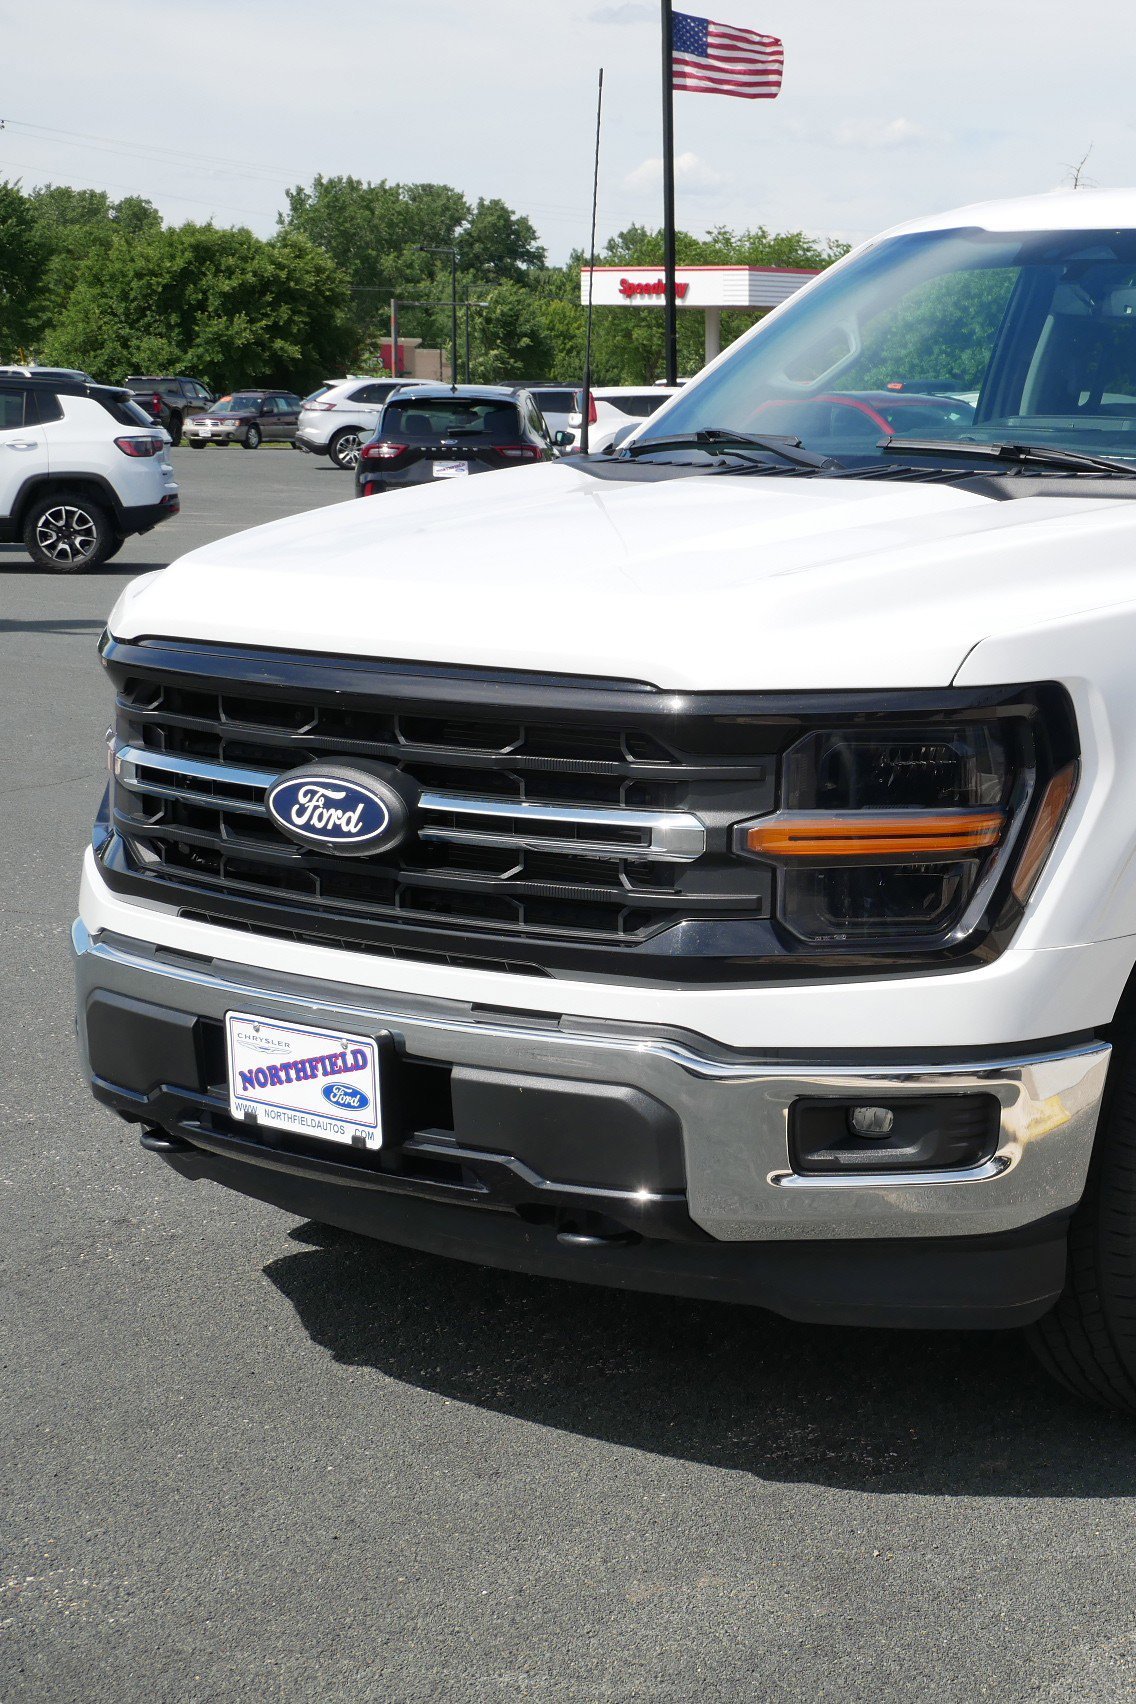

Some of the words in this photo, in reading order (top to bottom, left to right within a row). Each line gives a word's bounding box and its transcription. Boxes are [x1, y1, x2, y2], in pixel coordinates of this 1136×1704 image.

[291, 785, 364, 833] Ford
[237, 1032, 292, 1049] CHRYSLER
[238, 1048, 369, 1092] NORTHFIELD
[330, 1085, 360, 1107] Ford
[264, 1108, 345, 1135] NORTHFIELDAUTOS
